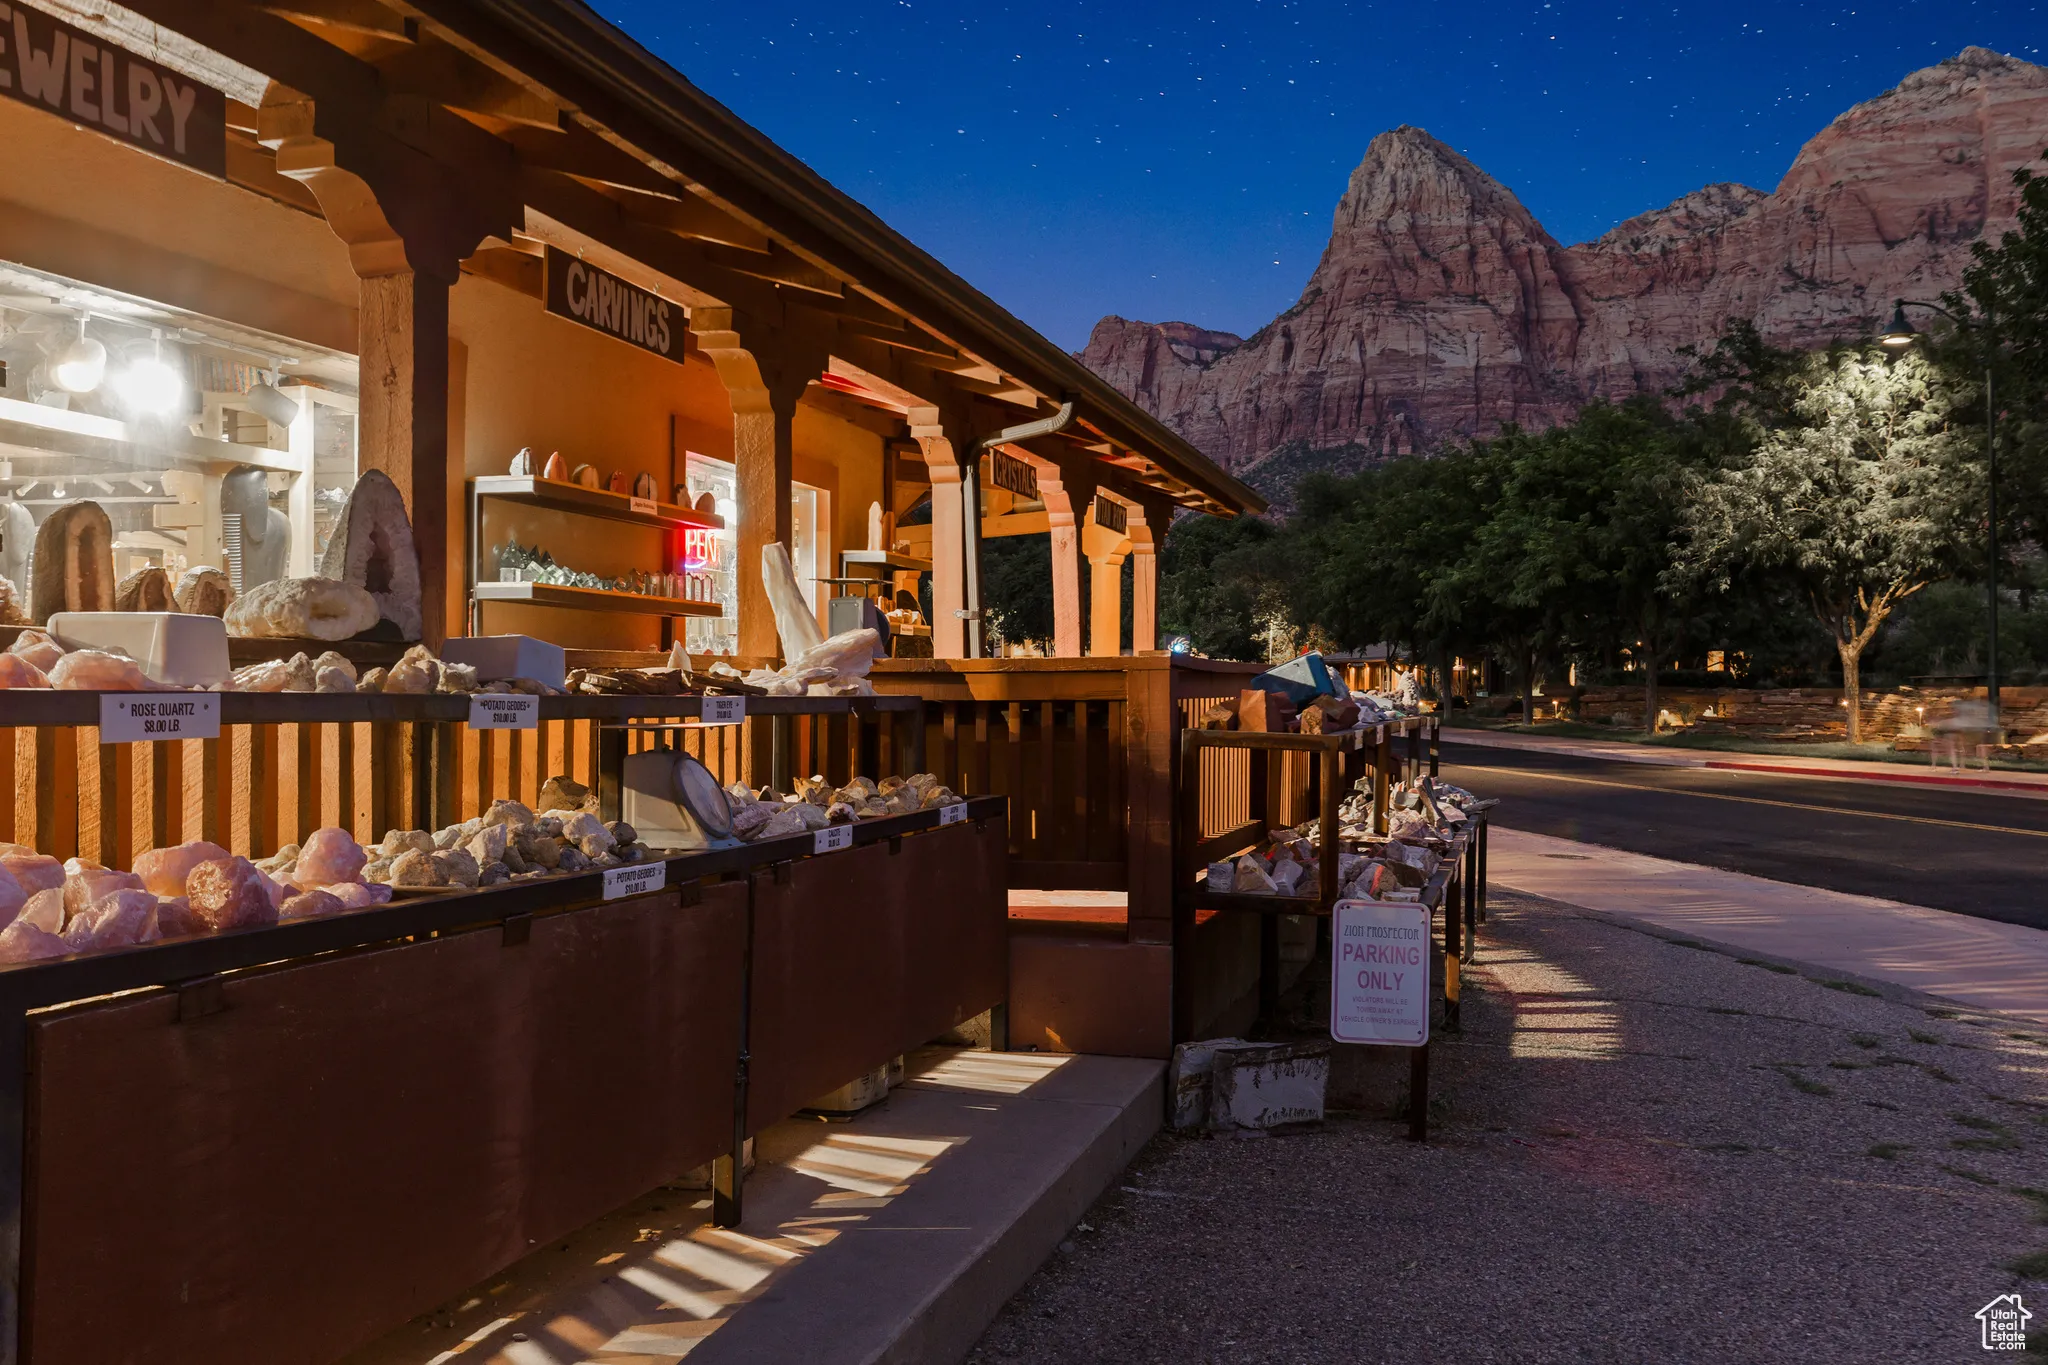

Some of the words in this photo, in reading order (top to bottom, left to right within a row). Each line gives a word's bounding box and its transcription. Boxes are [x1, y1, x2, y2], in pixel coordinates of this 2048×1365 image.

[567, 261, 670, 354] CARVINGS
[995, 452, 1036, 498] CRYSTALS
[686, 529, 718, 563] PEN
[131, 704, 156, 717] ROSE
[158, 703, 195, 716] QUARTZ
[484, 701, 505, 710] POTATO
[506, 702, 526, 711] GEODES
[144, 720, 167, 733] $8.00
[168, 719, 181, 732] LB.
[616, 870, 636, 883] POTATO
[637, 867, 656, 880] GEODES
[1344, 925, 1364, 938] ZION
[1367, 926, 1419, 940] PROSPECTOR
[1344, 943, 1420, 966] PARKING
[1358, 970, 1404, 990] ONLY
